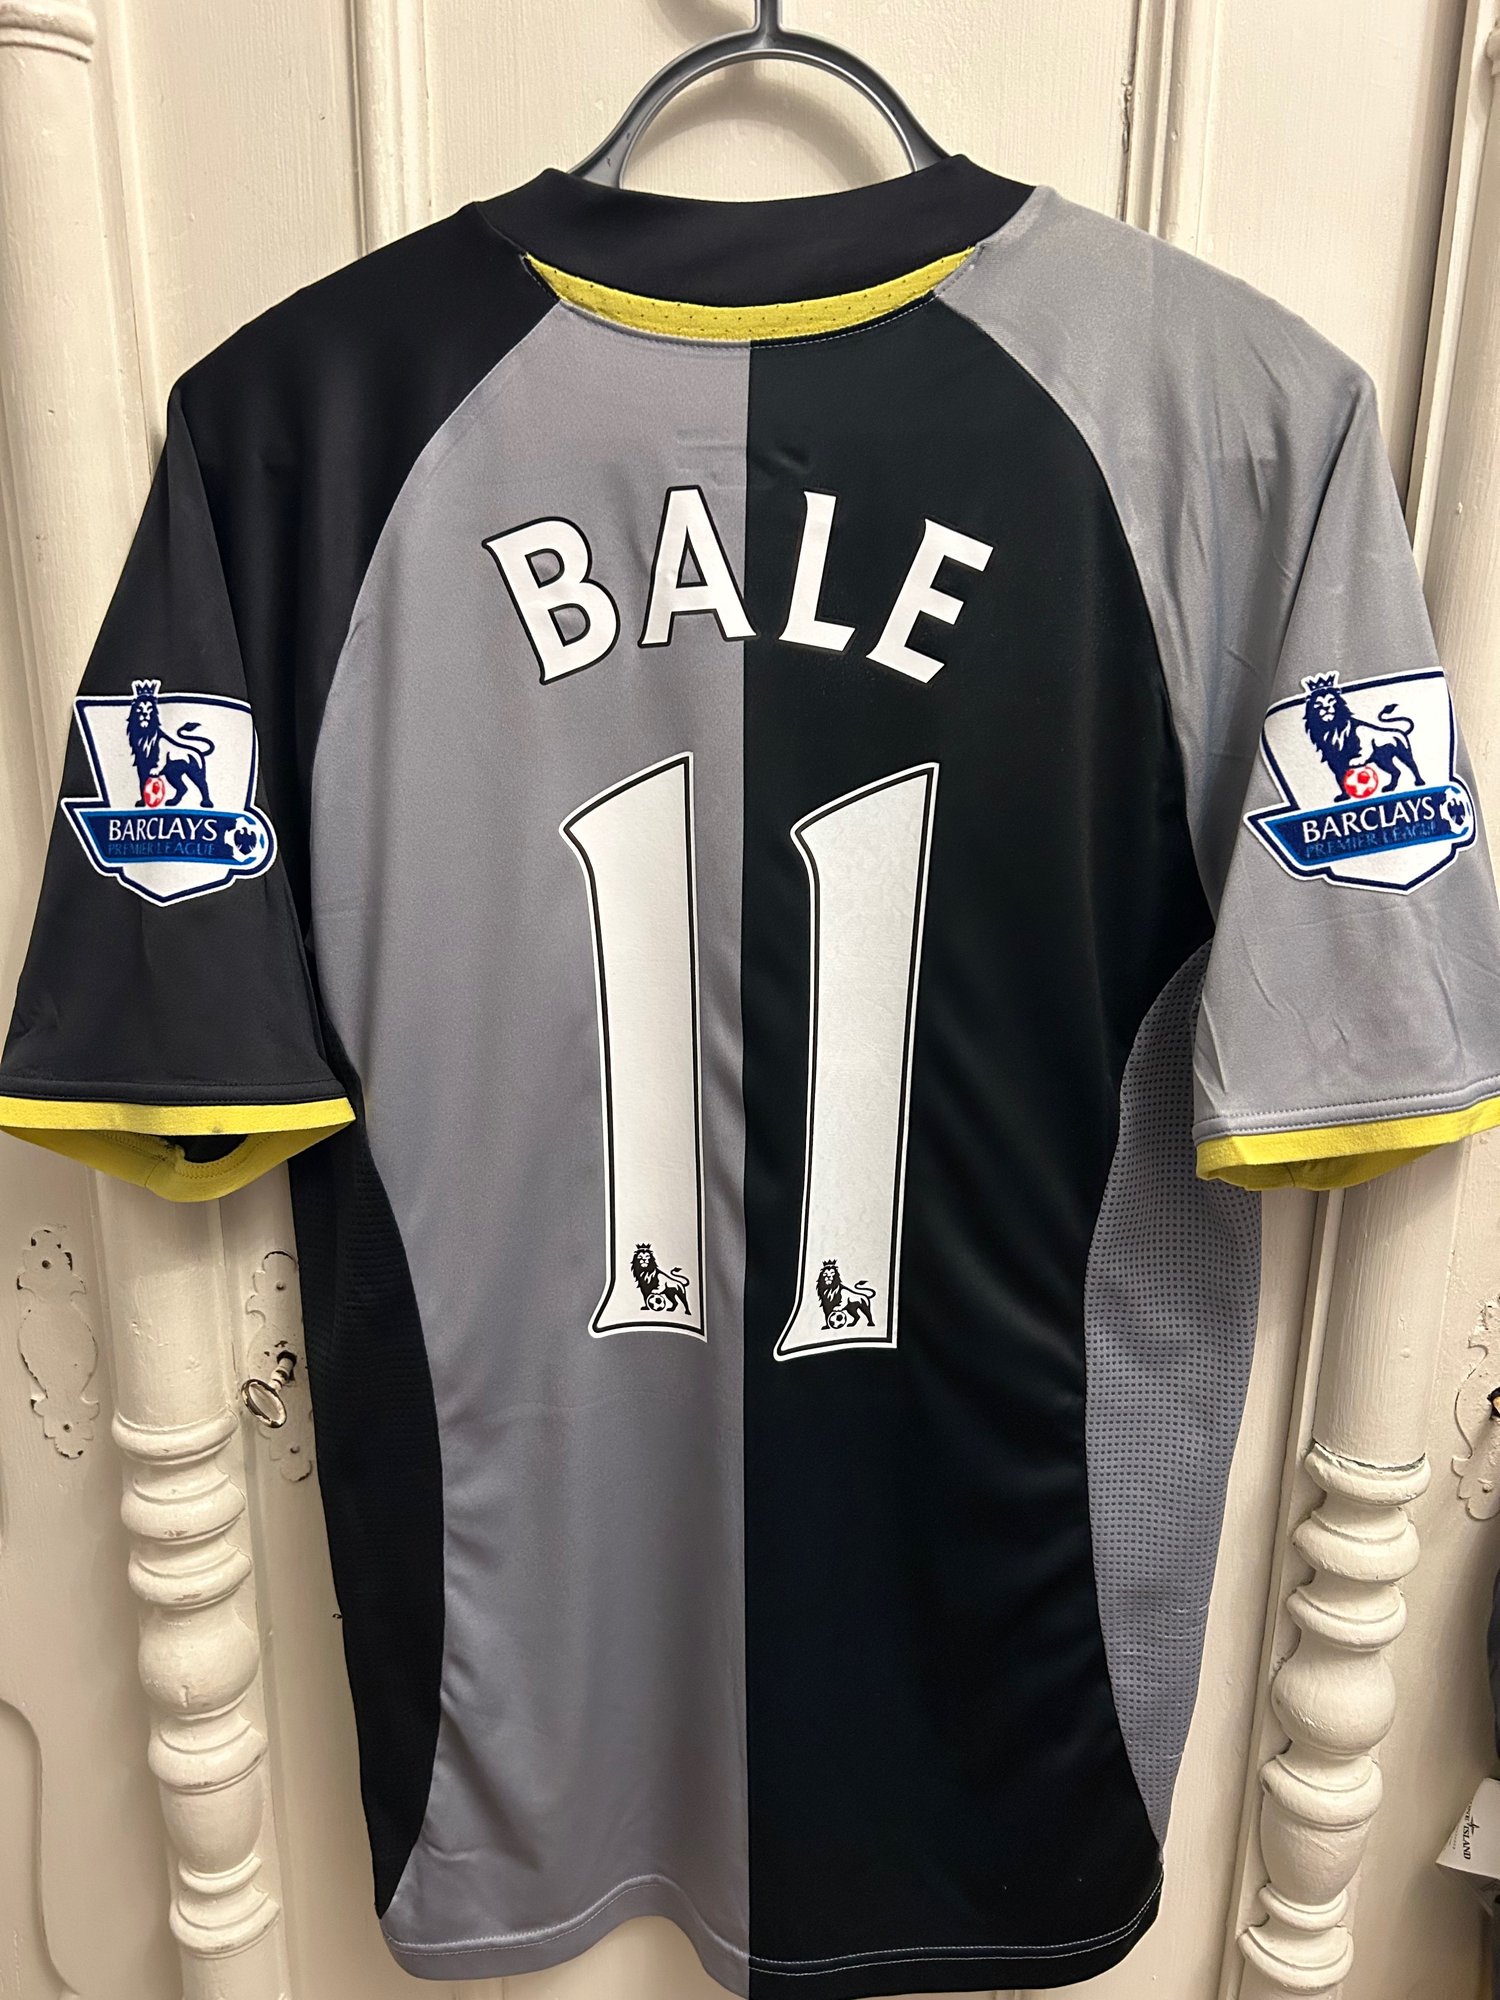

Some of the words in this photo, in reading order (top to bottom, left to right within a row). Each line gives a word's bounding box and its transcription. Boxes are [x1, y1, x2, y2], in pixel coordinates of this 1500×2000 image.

[482, 485, 994, 685] BALE
[108, 817, 218, 841] BARCLAYS
[1302, 796, 1435, 844] BARCLAYS
[1305, 833, 1378, 859] PREMIER
[1383, 820, 1437, 844] LEAGUE
[107, 843, 152, 856] PREMIER
[158, 842, 215, 856] LEAGUE
[558, 751, 940, 1362] 11
[1462, 1825, 1472, 1860] ISLAND
